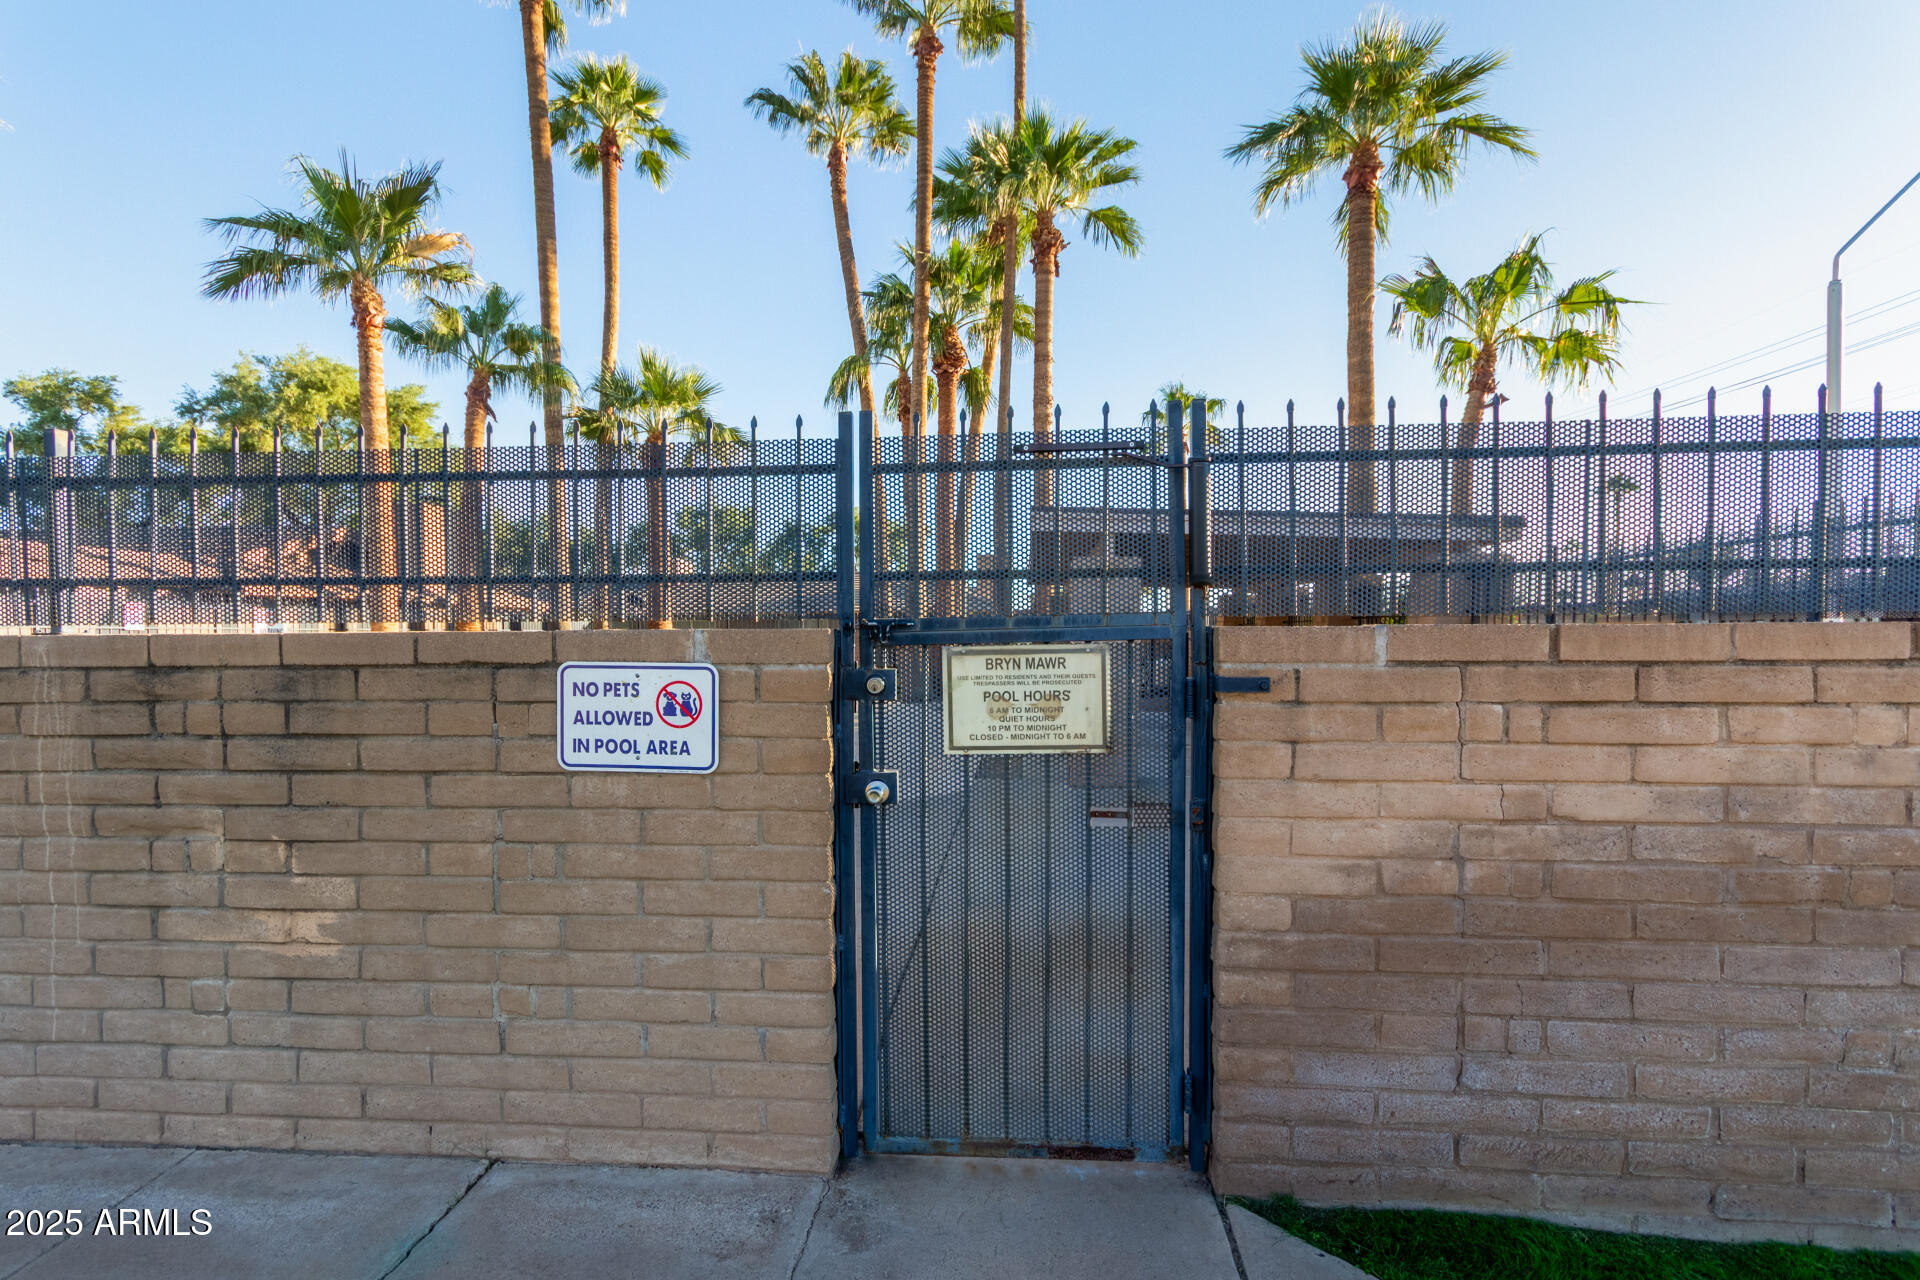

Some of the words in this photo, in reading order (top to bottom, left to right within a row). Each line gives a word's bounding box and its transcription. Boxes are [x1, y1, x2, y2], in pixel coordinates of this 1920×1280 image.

[986, 658, 1021, 670] BRYN
[1026, 657, 1066, 669] MAWR
[573, 682, 599, 697] NO
[603, 682, 640, 698] PETS
[984, 691, 1020, 702] POOL
[1024, 690, 1070, 702] HOURS
[573, 710, 654, 726] ALLOWED
[572, 738, 590, 753] IN
[594, 739, 641, 754] POOL
[646, 740, 691, 756] AREA
